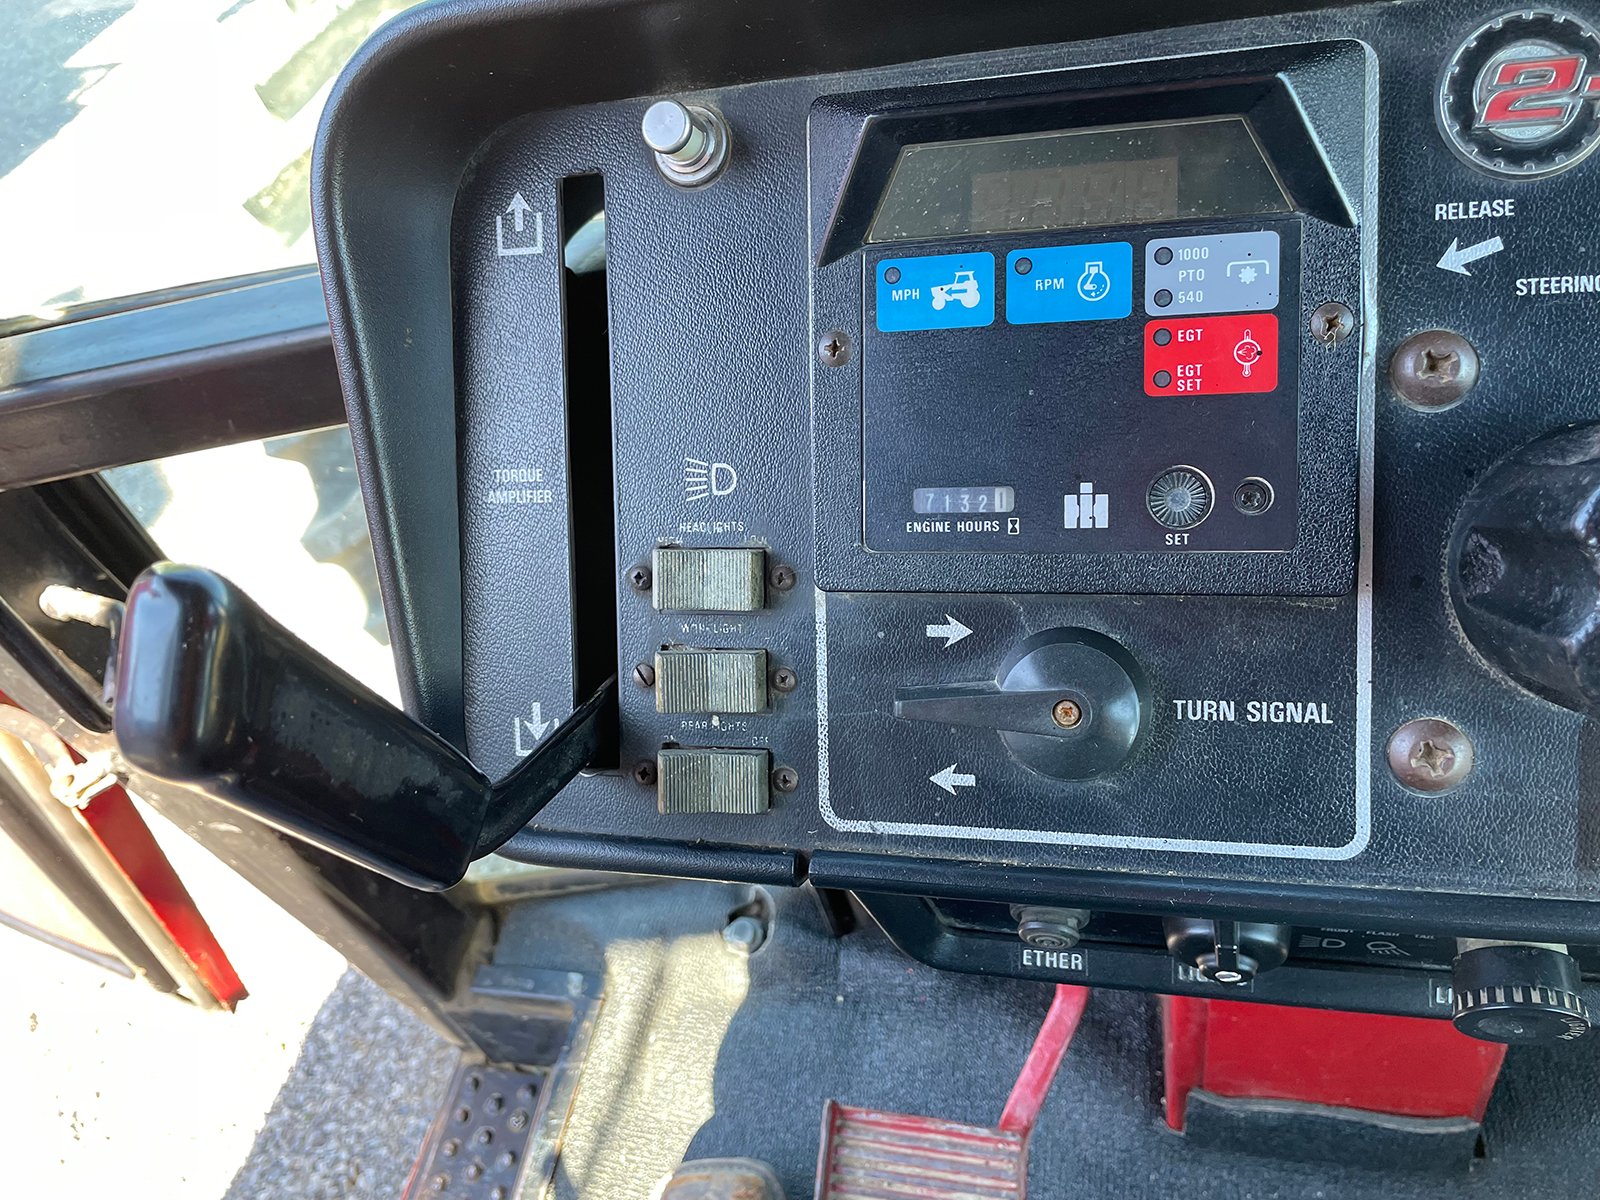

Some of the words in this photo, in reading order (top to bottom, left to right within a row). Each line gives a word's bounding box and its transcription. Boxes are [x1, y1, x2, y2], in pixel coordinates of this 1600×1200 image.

[1435, 199, 1515, 221] RELEASE
[1178, 247, 1209, 261] 1000
[1179, 268, 1205, 282] PTO
[1035, 278, 1065, 291] RPM
[891, 288, 920, 302] MPH
[1178, 290, 1203, 304] 540
[1177, 329, 1203, 342] EGT
[1177, 364, 1203, 377] EGT
[1177, 379, 1202, 392] SET
[494, 469, 544, 482] TORQUE
[488, 490, 553, 504] AMPLIFIER
[906, 521, 951, 533] ENGINE
[957, 520, 1000, 532] HOURS
[1165, 533, 1190, 546] SET
[1173, 700, 1235, 722] TURN
[1246, 701, 1333, 724] SIGNAL
[1022, 950, 1083, 971] ETHER
